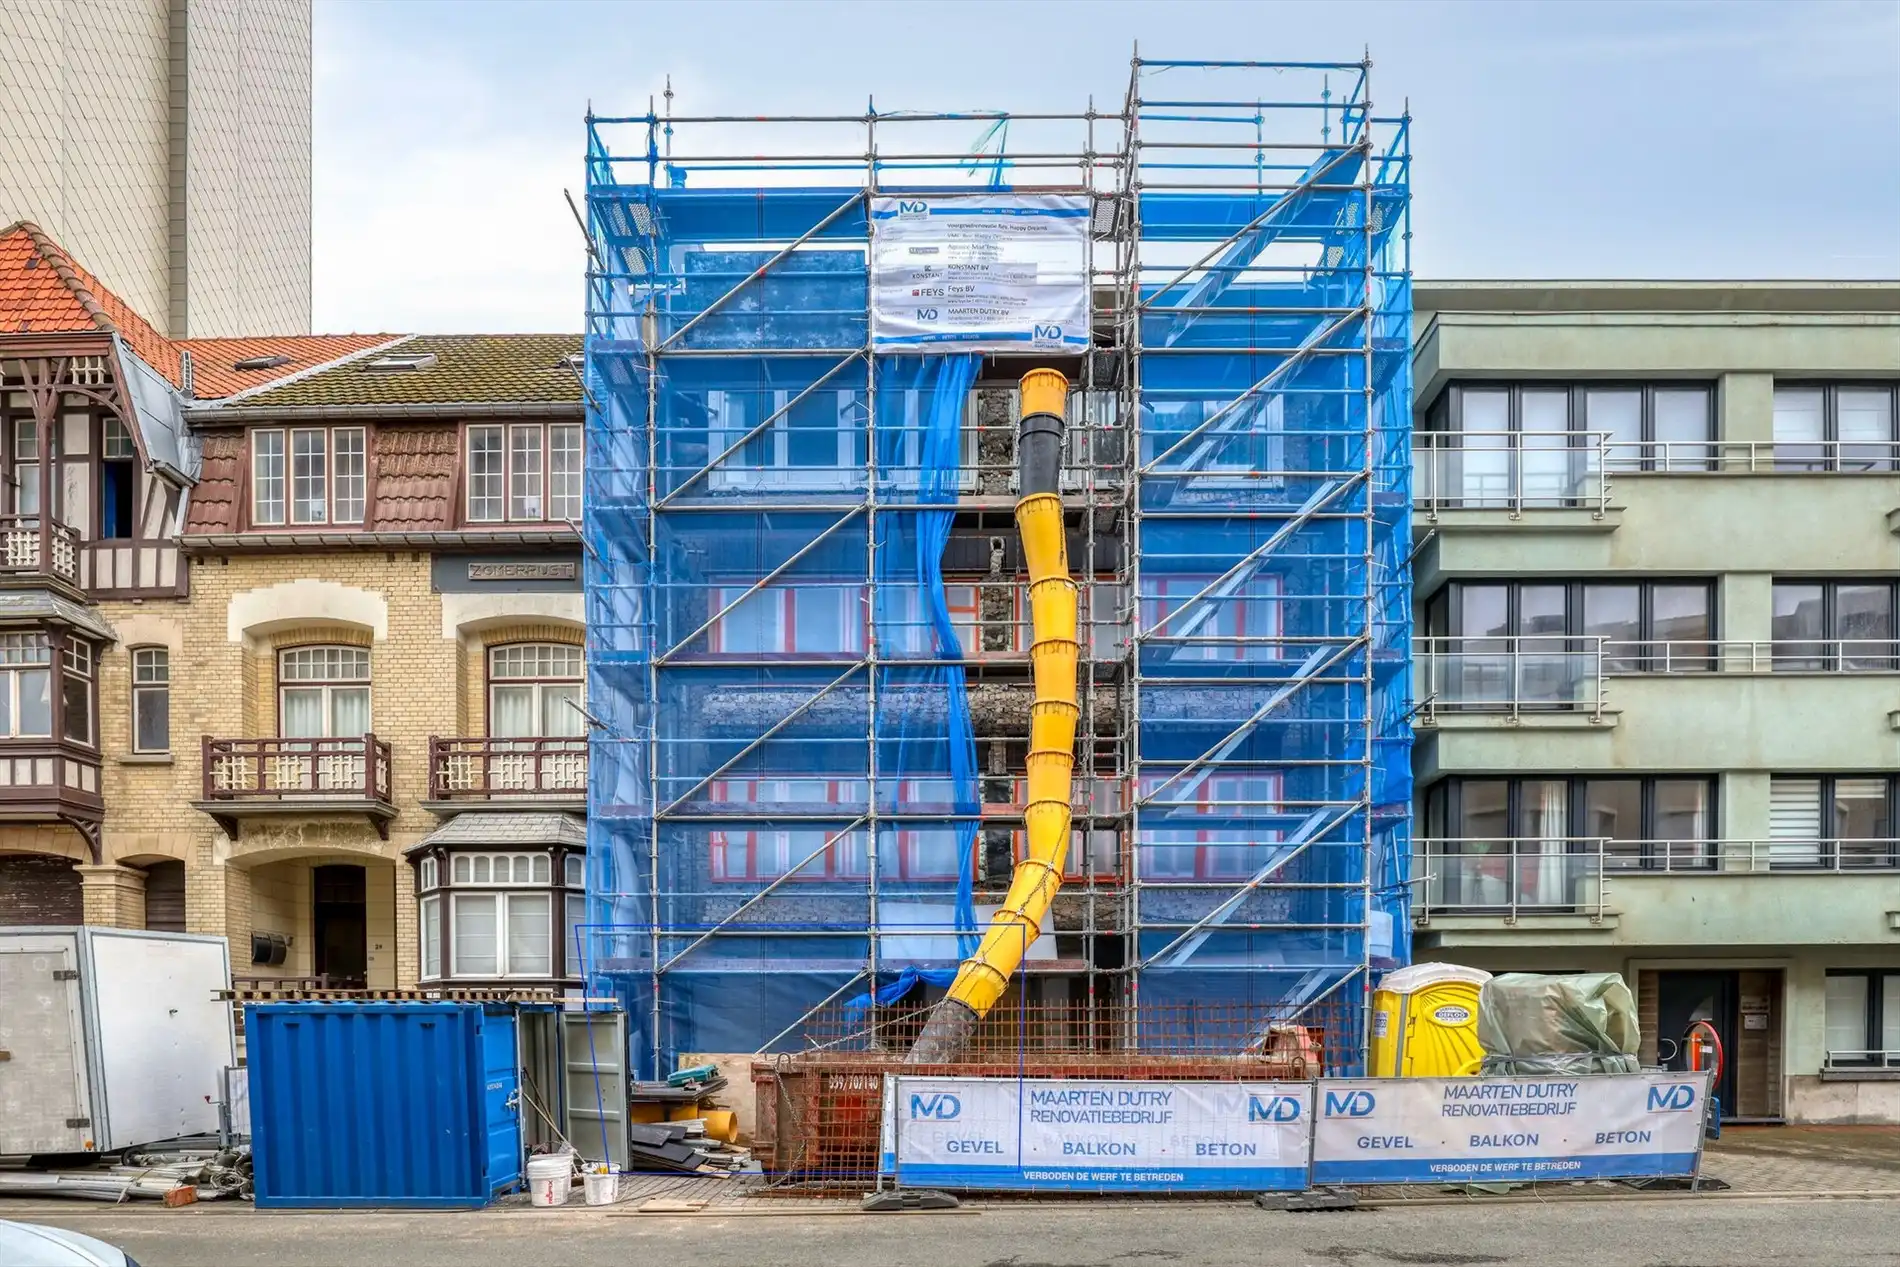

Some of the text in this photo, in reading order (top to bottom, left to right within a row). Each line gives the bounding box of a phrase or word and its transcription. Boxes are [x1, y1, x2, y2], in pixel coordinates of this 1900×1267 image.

[900, 201, 928, 213] MD
[920, 288, 945, 297] FEYS
[947, 285, 964, 293] Feys
[917, 309, 938, 320] MD
[979, 308, 999, 316] DUTRY
[1034, 324, 1062, 339] MD
[472, 564, 570, 577] ZOMERRUST
[1031, 1090, 1172, 1107] MAARTEN DUTRY
[1443, 1083, 1578, 1100] MAARTEN DUTRY
[1647, 1085, 1696, 1111] MD
[911, 1094, 961, 1120] MD
[1248, 1096, 1301, 1122] MD
[1324, 1091, 1375, 1117] MD
[1442, 1102, 1577, 1117] RENOVATIEBEDRIJF
[1030, 1108, 1173, 1125] RENOVATIEBEDRIJF
[1357, 1131, 1652, 1149] GEVEL BALKON BETON
[946, 1139, 1257, 1157] GEVEL BALKON BETON
[1429, 1161, 1581, 1173] VERBODEN DE WERF TE BETREDEN
[1023, 1171, 1184, 1183] VERBODEN DE WERF TE BETREDEN
